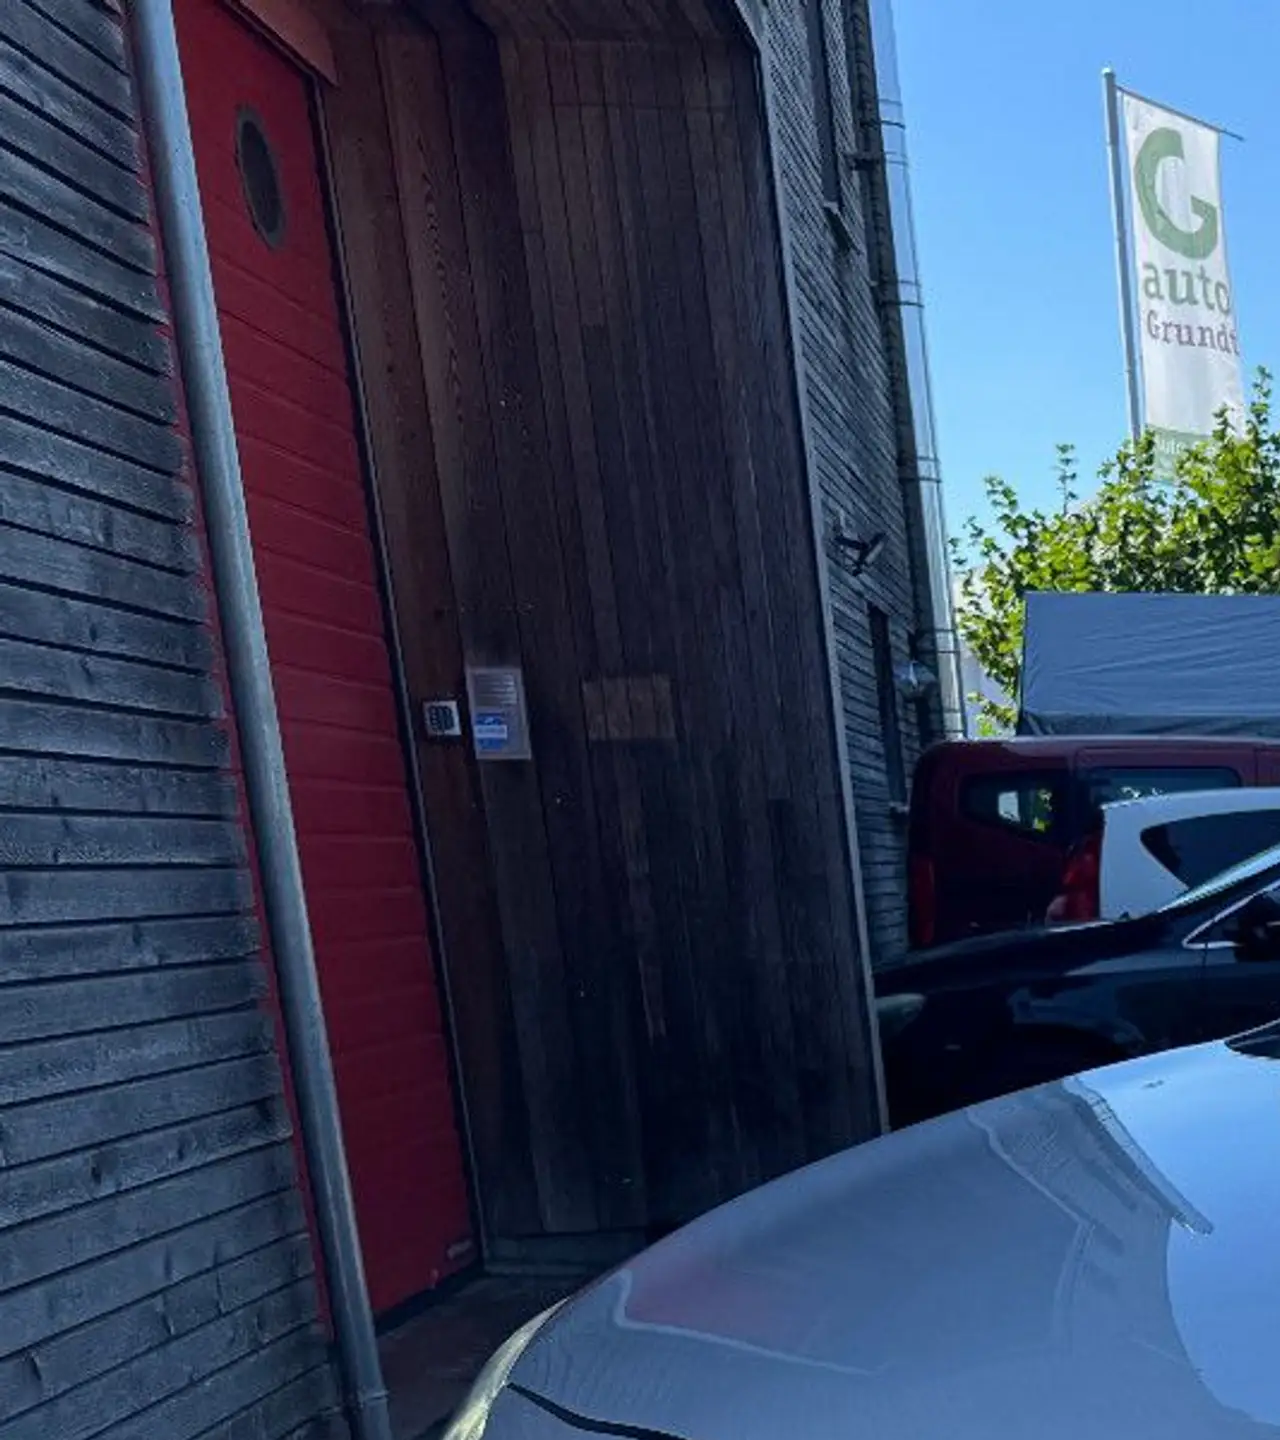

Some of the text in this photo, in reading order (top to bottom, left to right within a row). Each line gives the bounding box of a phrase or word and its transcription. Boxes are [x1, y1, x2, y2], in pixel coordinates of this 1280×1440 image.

[1134, 127, 1218, 258] G
[1142, 262, 1230, 315] auto
[1147, 309, 1240, 355] Grundt
